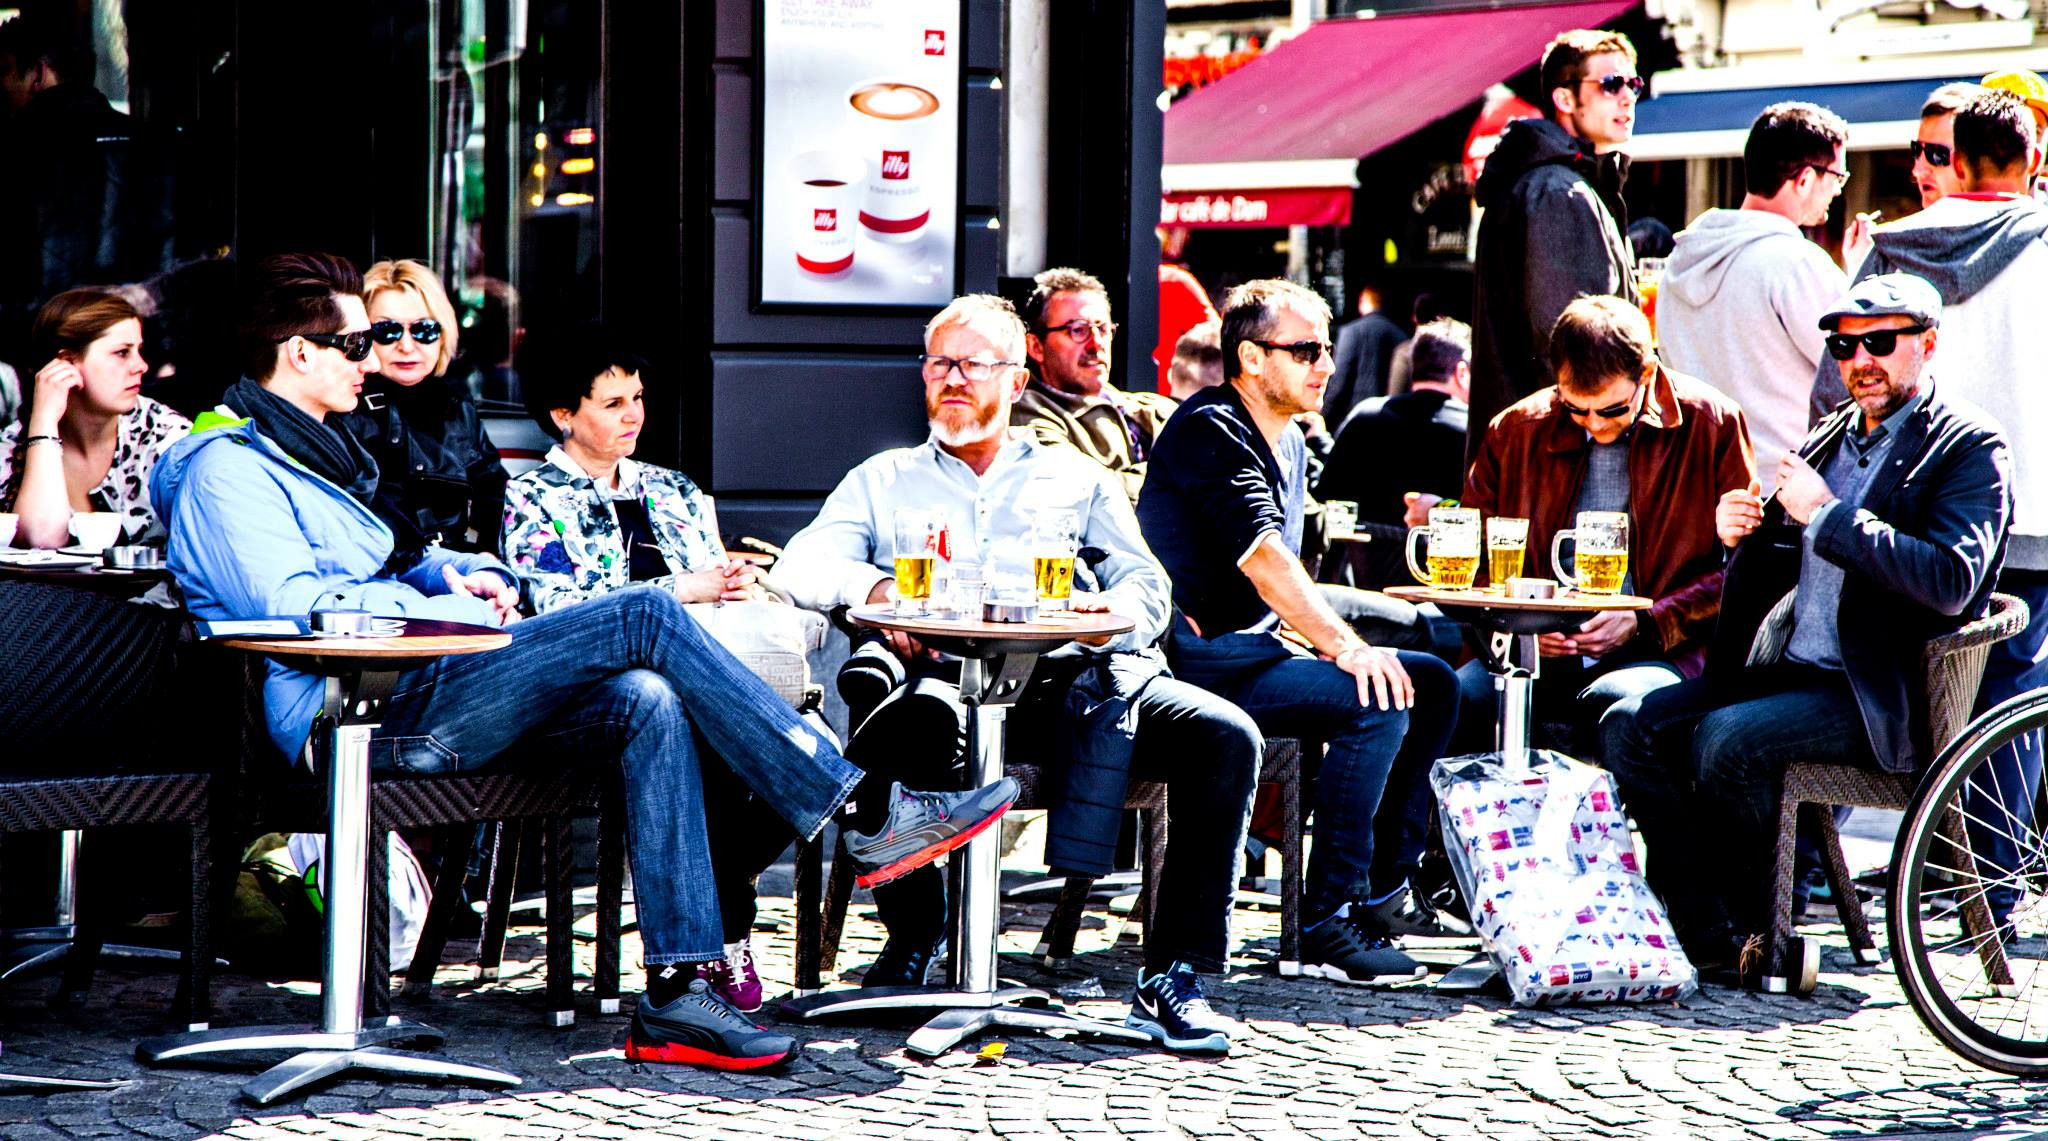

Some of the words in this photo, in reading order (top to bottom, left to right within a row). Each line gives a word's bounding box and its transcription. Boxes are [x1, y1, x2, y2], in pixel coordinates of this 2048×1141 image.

[925, 33, 945, 54] illy
[883, 155, 909, 178] illy
[815, 212, 837, 230] illy
